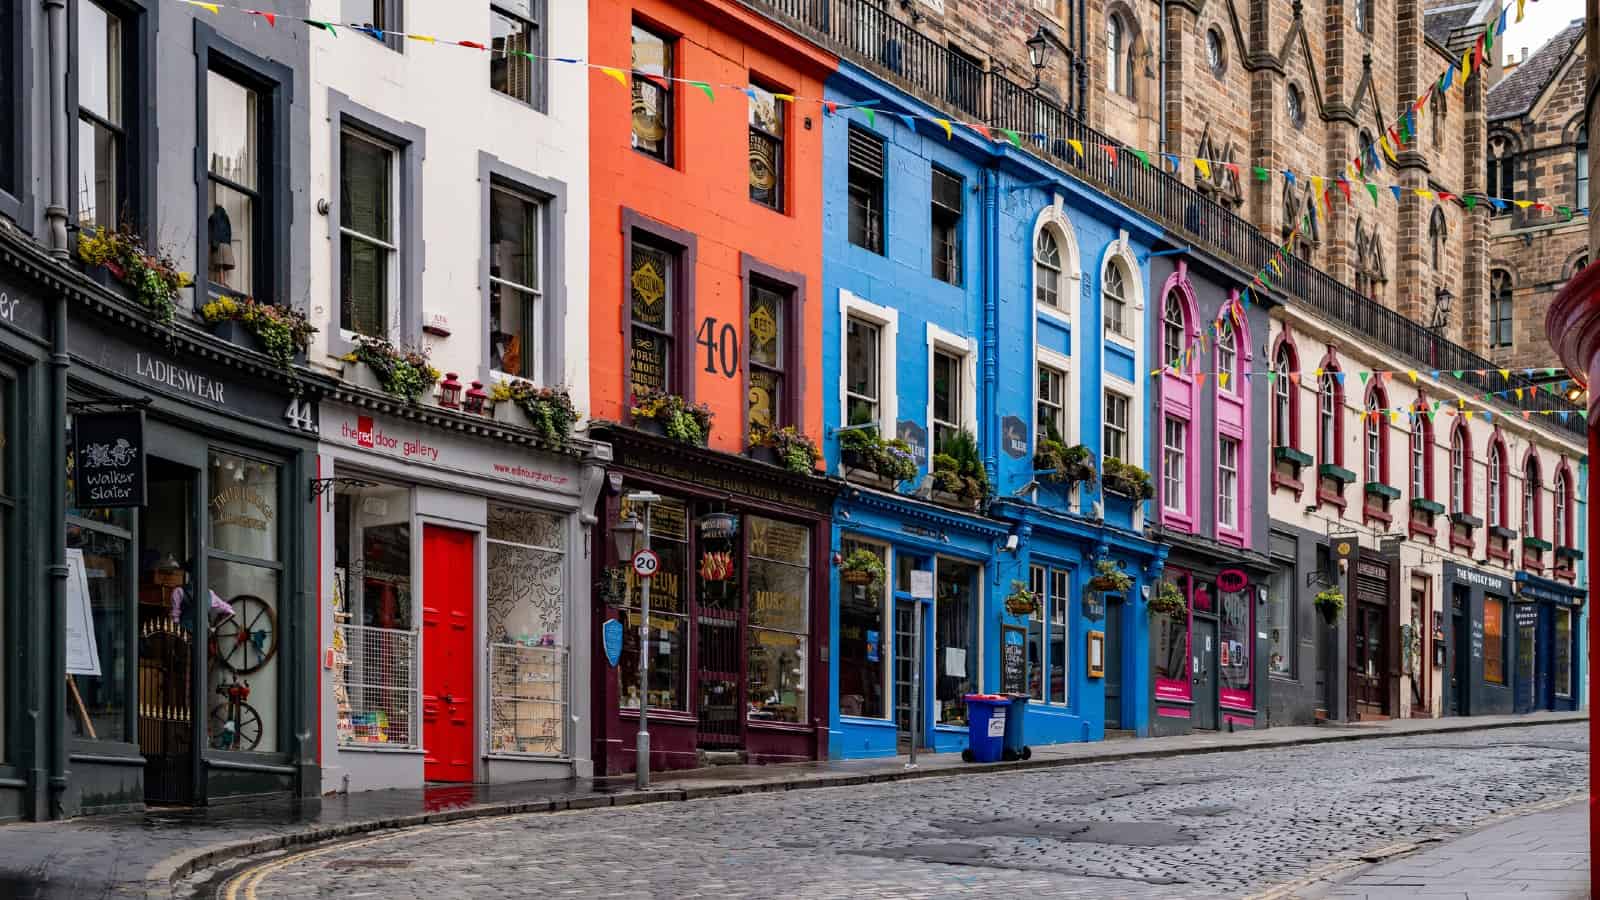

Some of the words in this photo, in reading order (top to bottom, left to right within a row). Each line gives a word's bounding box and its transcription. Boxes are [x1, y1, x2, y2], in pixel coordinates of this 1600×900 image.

[697, 317, 738, 378] 40
[136, 352, 225, 403] LADIESWEAR
[342, 421, 357, 439] the
[358, 427, 373, 443] red
[375, 430, 398, 449] door
[403, 439, 438, 461] gallery
[637, 556, 656, 571] 20
[1457, 567, 1467, 579] THE
[1467, 569, 1488, 586] WHISKY
[1488, 576, 1502, 589] SHOP
